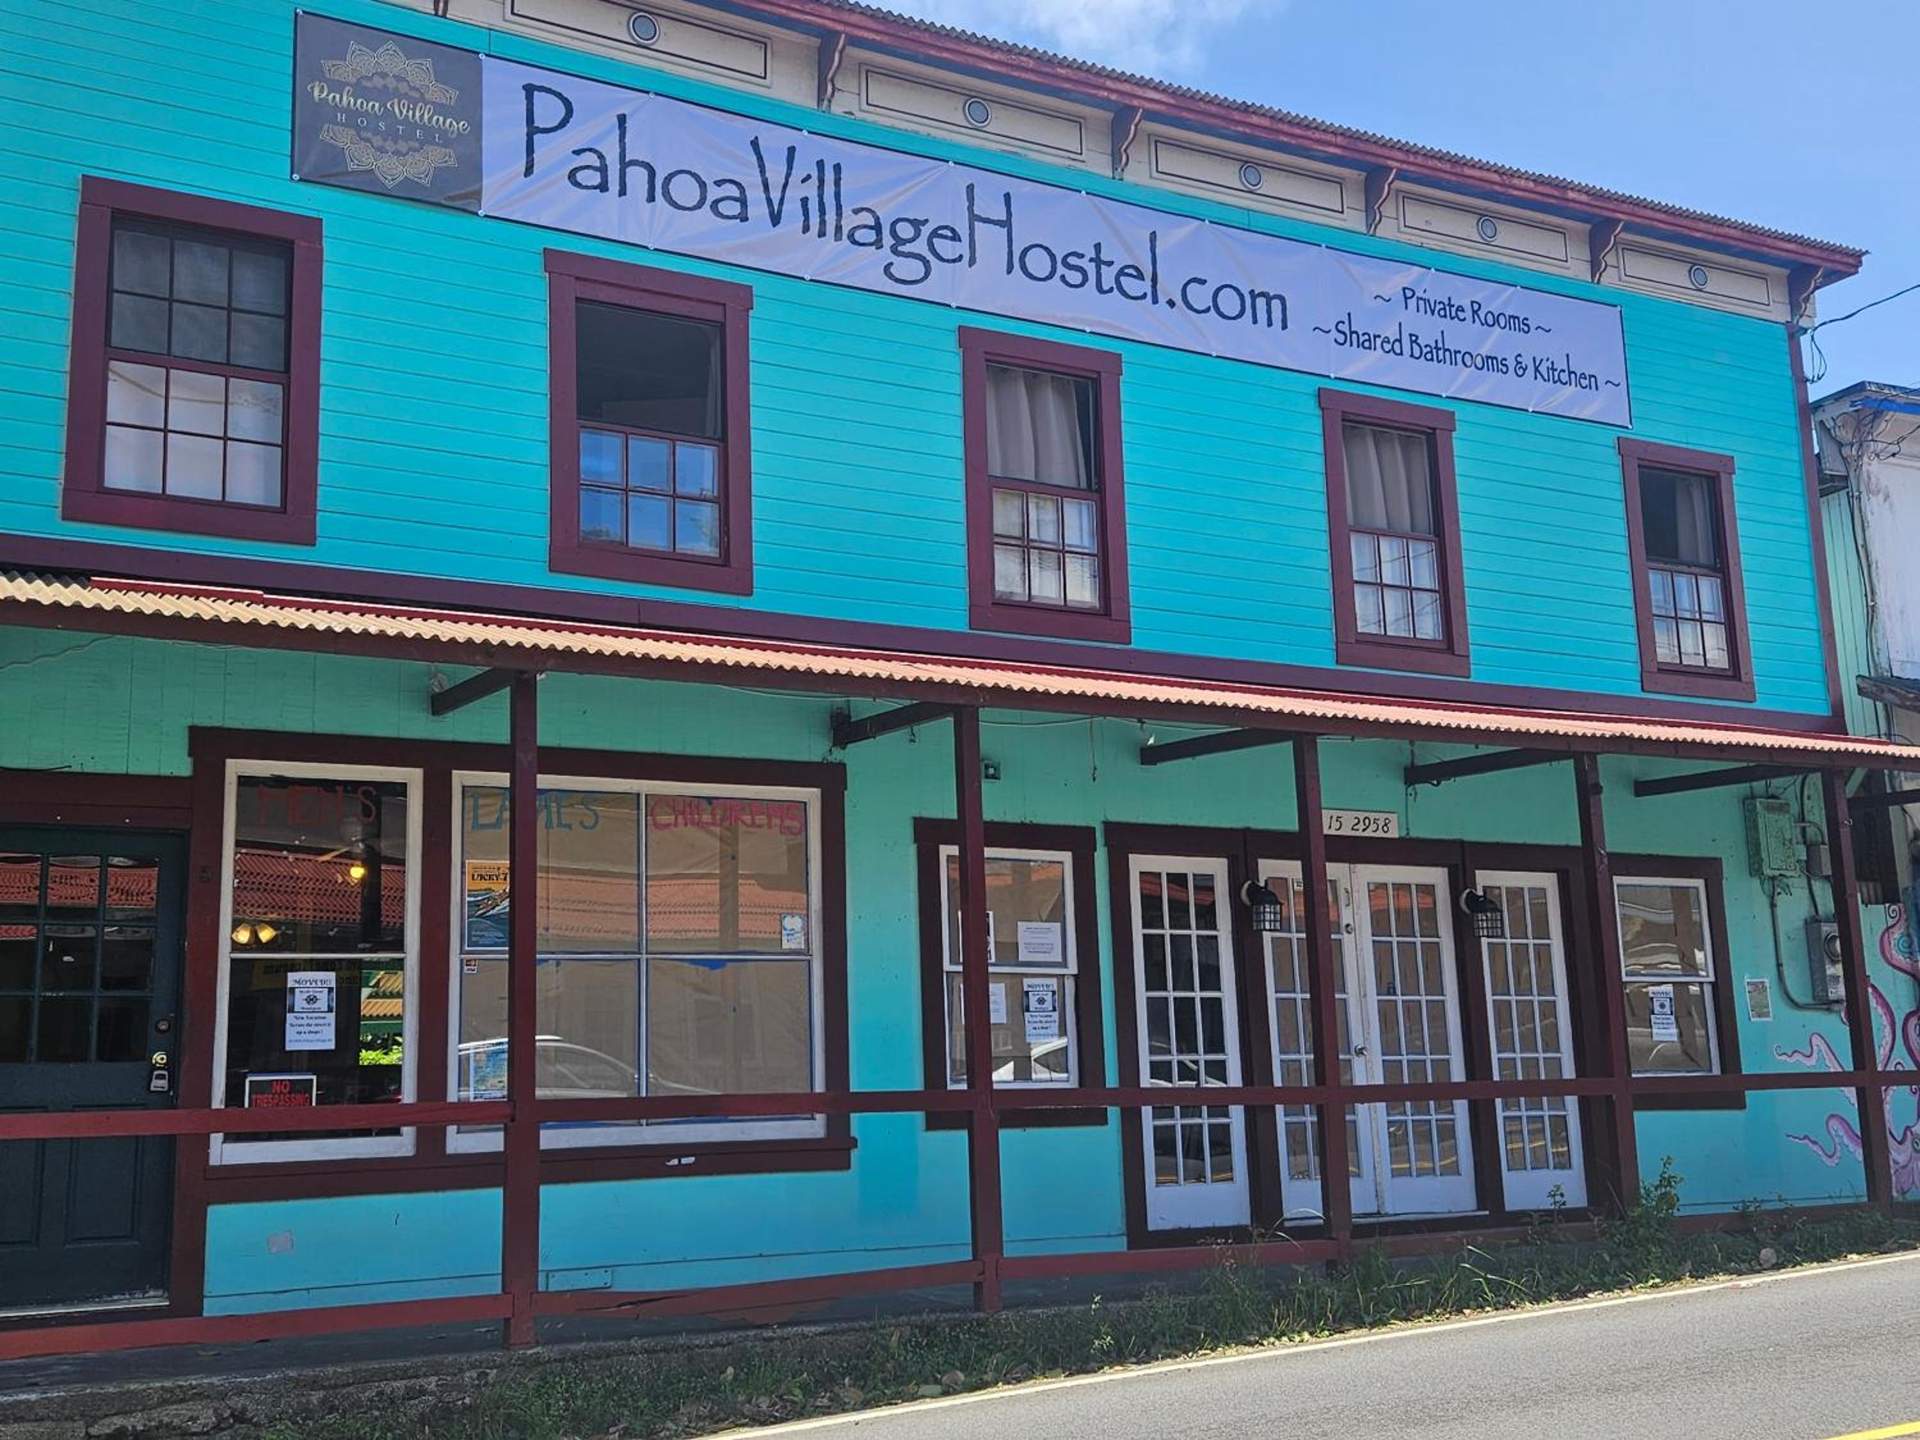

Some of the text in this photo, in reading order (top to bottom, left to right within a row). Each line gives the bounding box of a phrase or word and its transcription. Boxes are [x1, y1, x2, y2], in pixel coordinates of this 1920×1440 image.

[307, 80, 471, 138] Pahoa Village
[336, 112, 443, 144] HOSTEL
[522, 83, 1289, 330] PahoaVillageHostel.com
[1401, 286, 1466, 322] Private
[1470, 300, 1531, 334] Rooms
[1408, 330, 1509, 377] Bathrooms
[1514, 354, 1528, 377] &
[1532, 353, 1599, 391] Kitchen
[1327, 815, 1391, 833] 15 2958
[251, 1092, 310, 1108] TRESPASSING
[271, 1080, 290, 1094] NO
